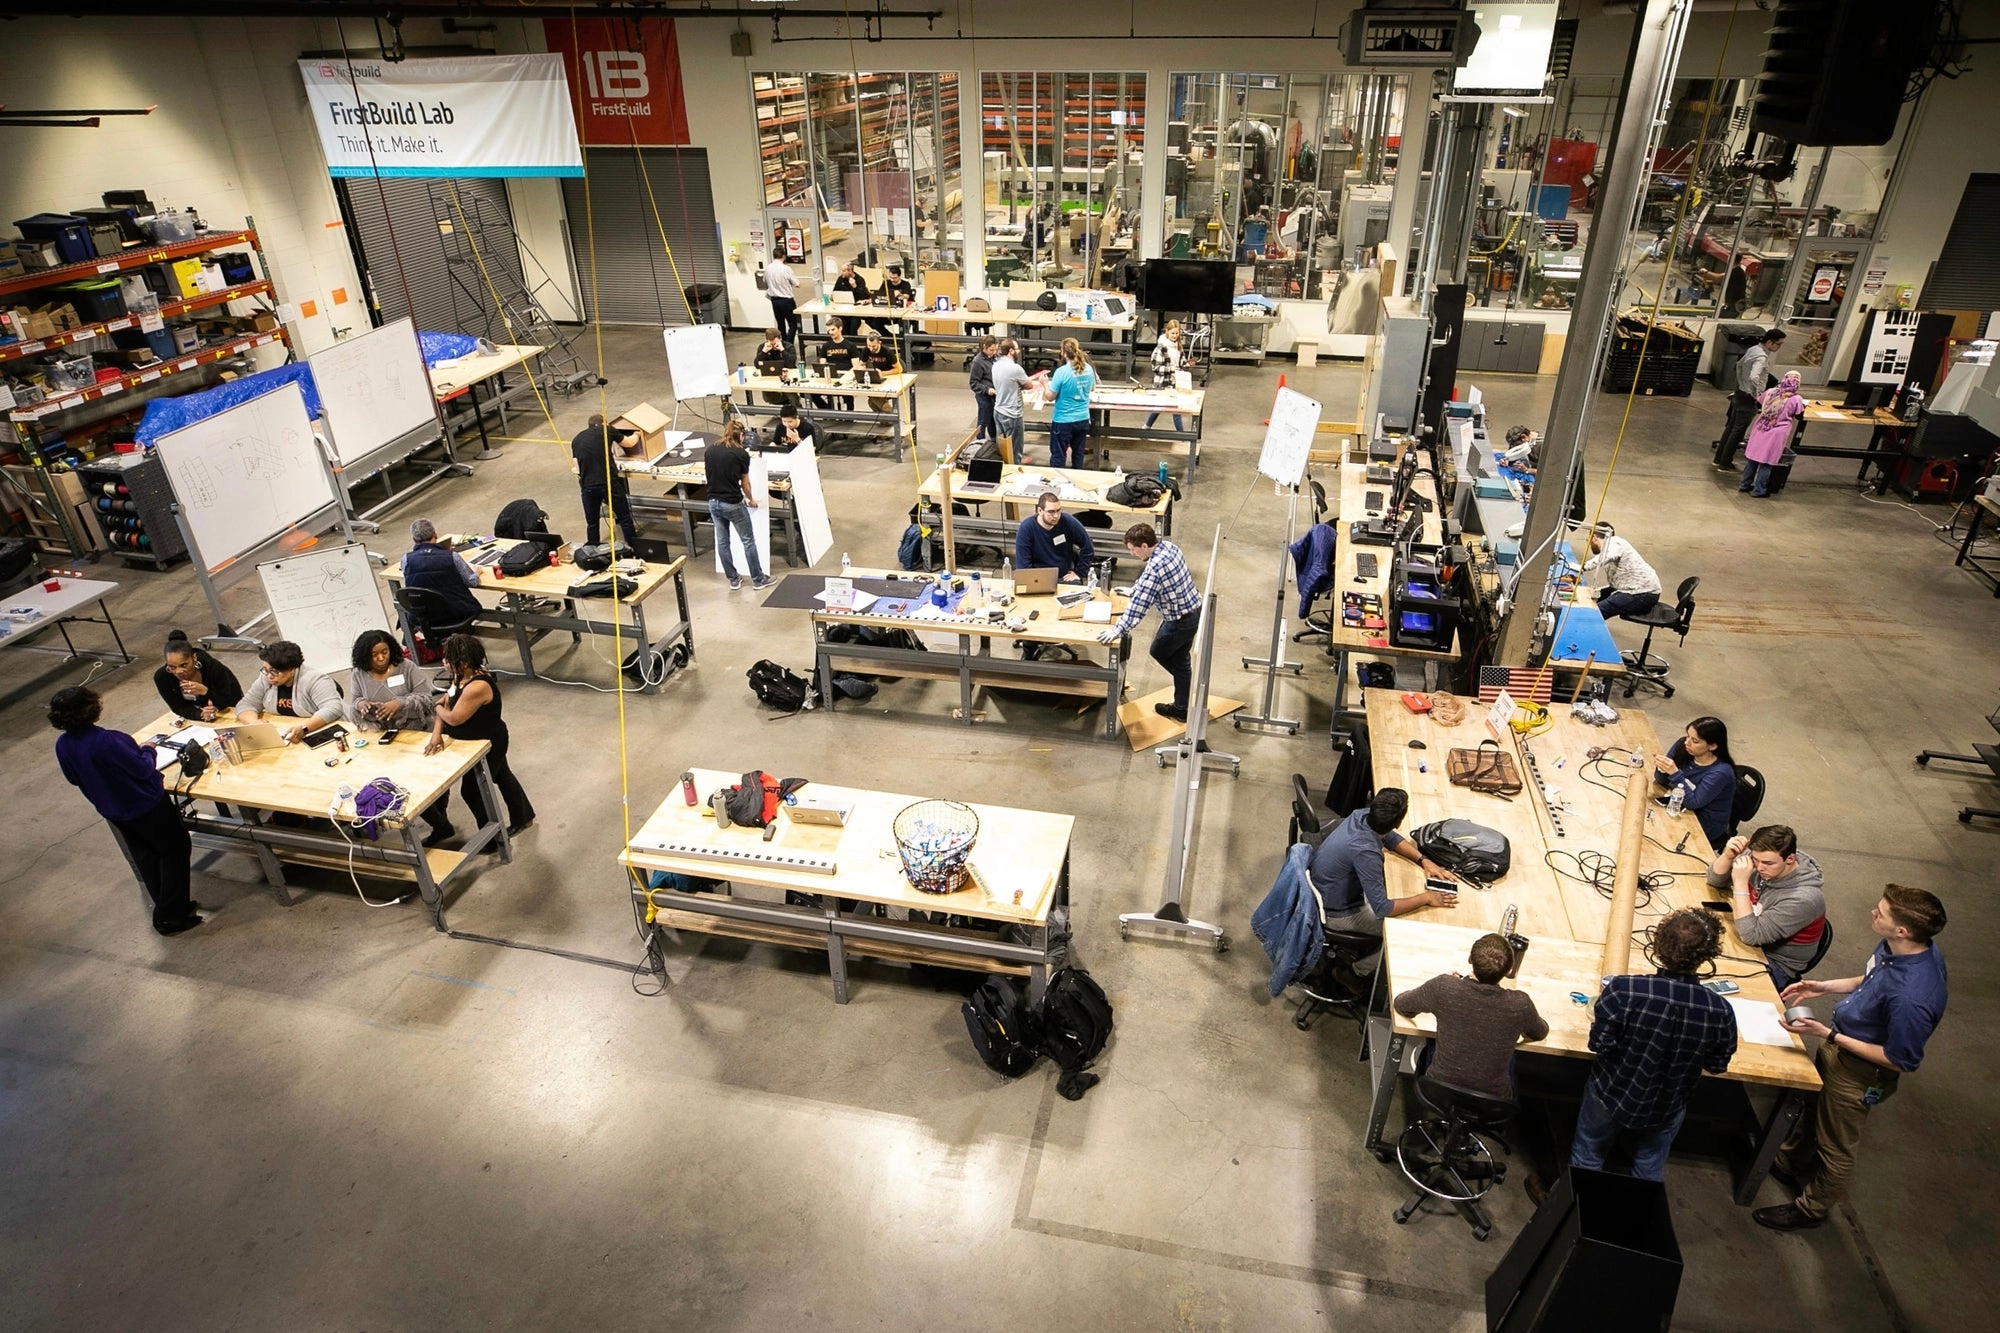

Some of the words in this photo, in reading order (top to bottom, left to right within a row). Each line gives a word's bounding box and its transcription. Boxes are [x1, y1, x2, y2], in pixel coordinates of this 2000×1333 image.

[335, 65, 382, 78] firsbuild
[329, 101, 418, 125] FirstBuild
[418, 101, 454, 125] Lab
[591, 102, 652, 116] FirstBuild
[376, 135, 391, 153] it.
[391, 135, 425, 153] Make
[428, 135, 444, 153] it.
